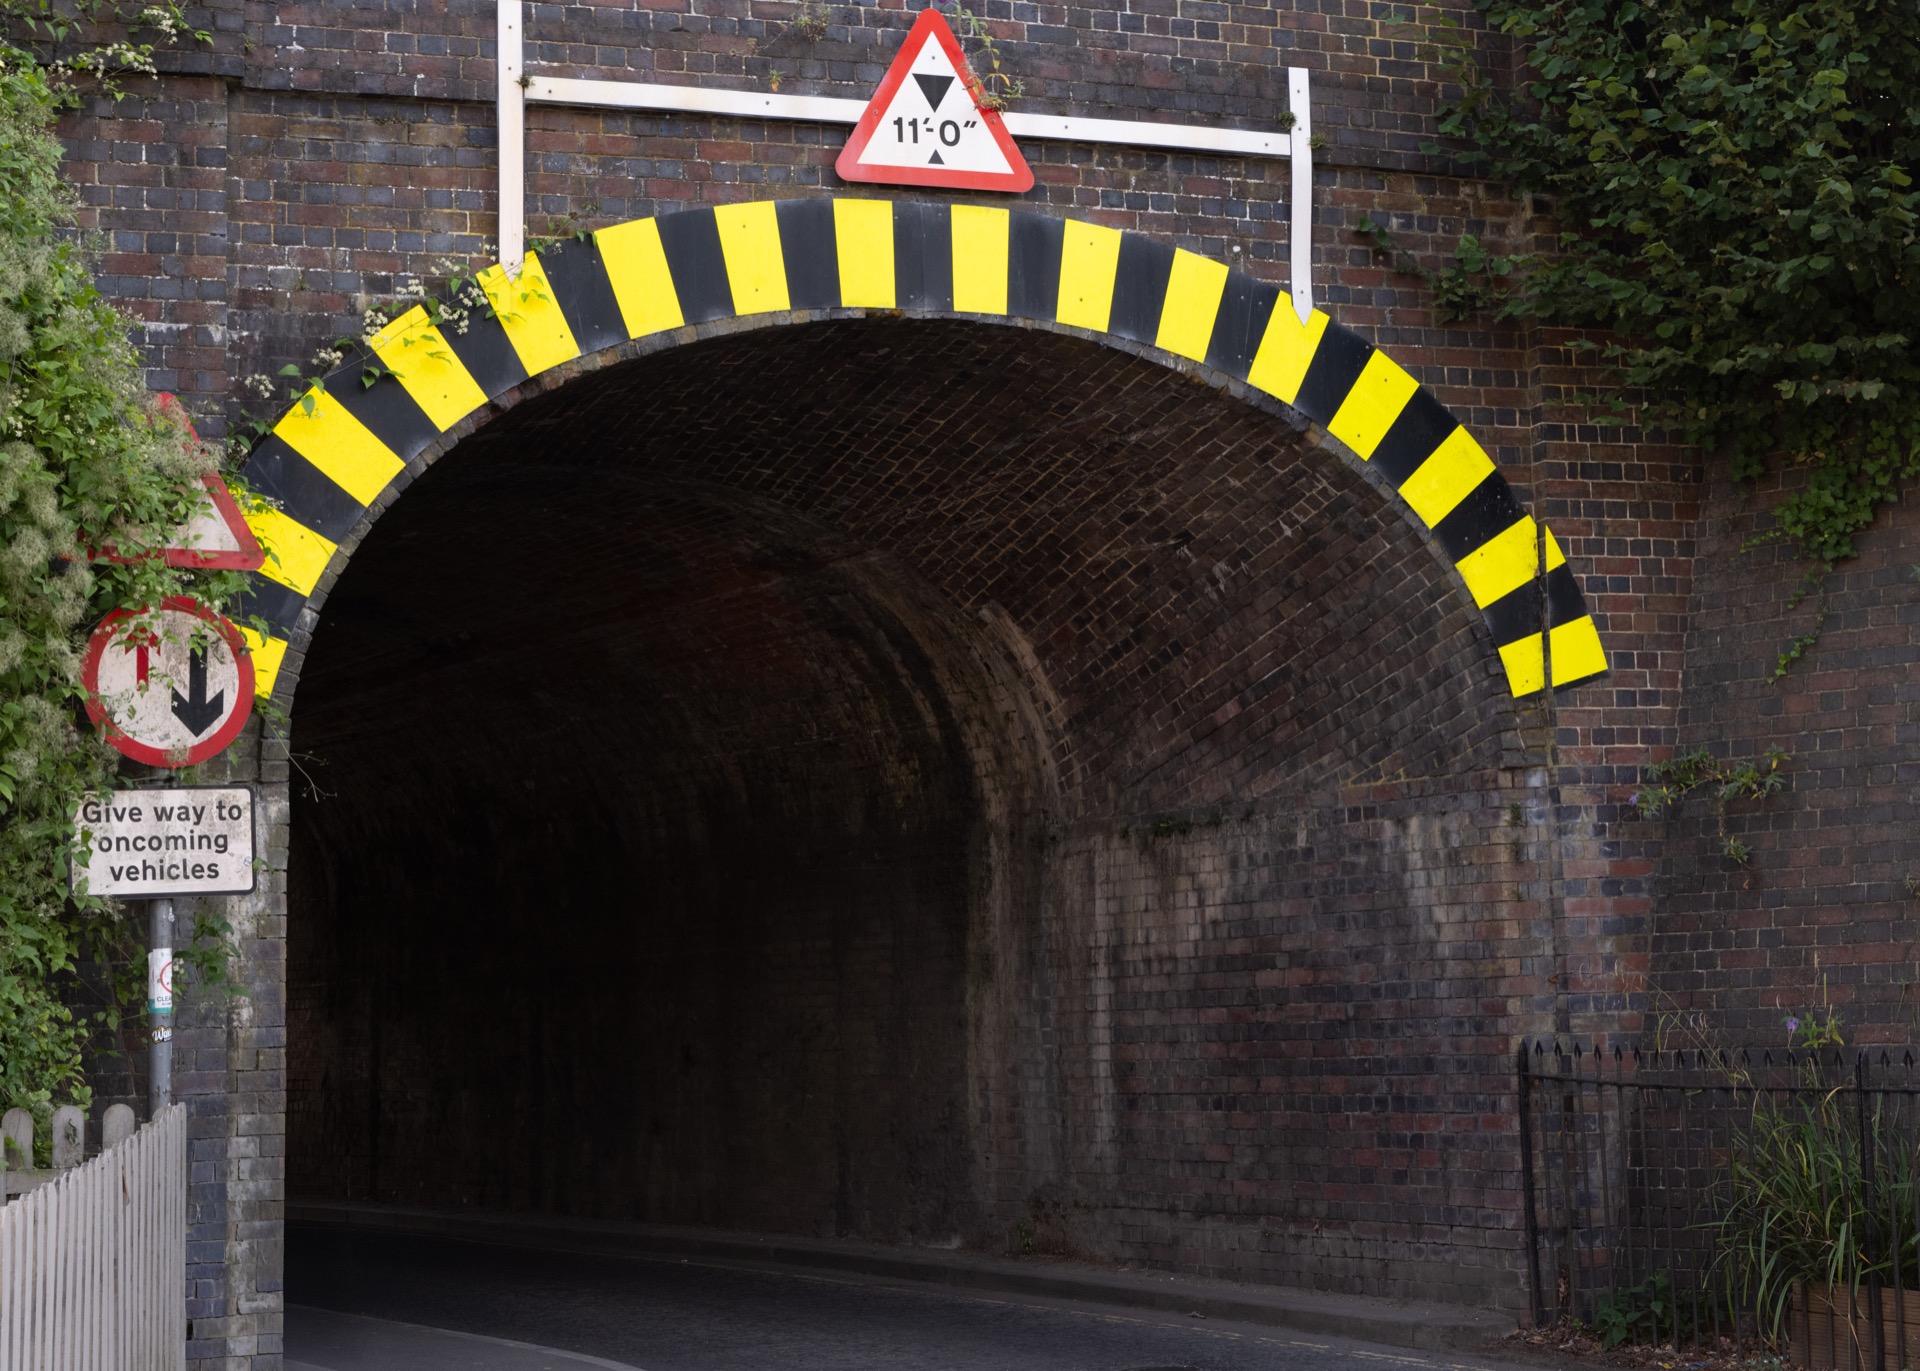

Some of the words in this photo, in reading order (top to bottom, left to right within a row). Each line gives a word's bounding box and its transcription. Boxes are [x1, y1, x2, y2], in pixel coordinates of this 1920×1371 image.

[82, 801, 142, 823] Give
[153, 804, 206, 825] way
[216, 800, 243, 821] to
[98, 829, 228, 854] oncoming
[109, 858, 220, 882] vehicles
